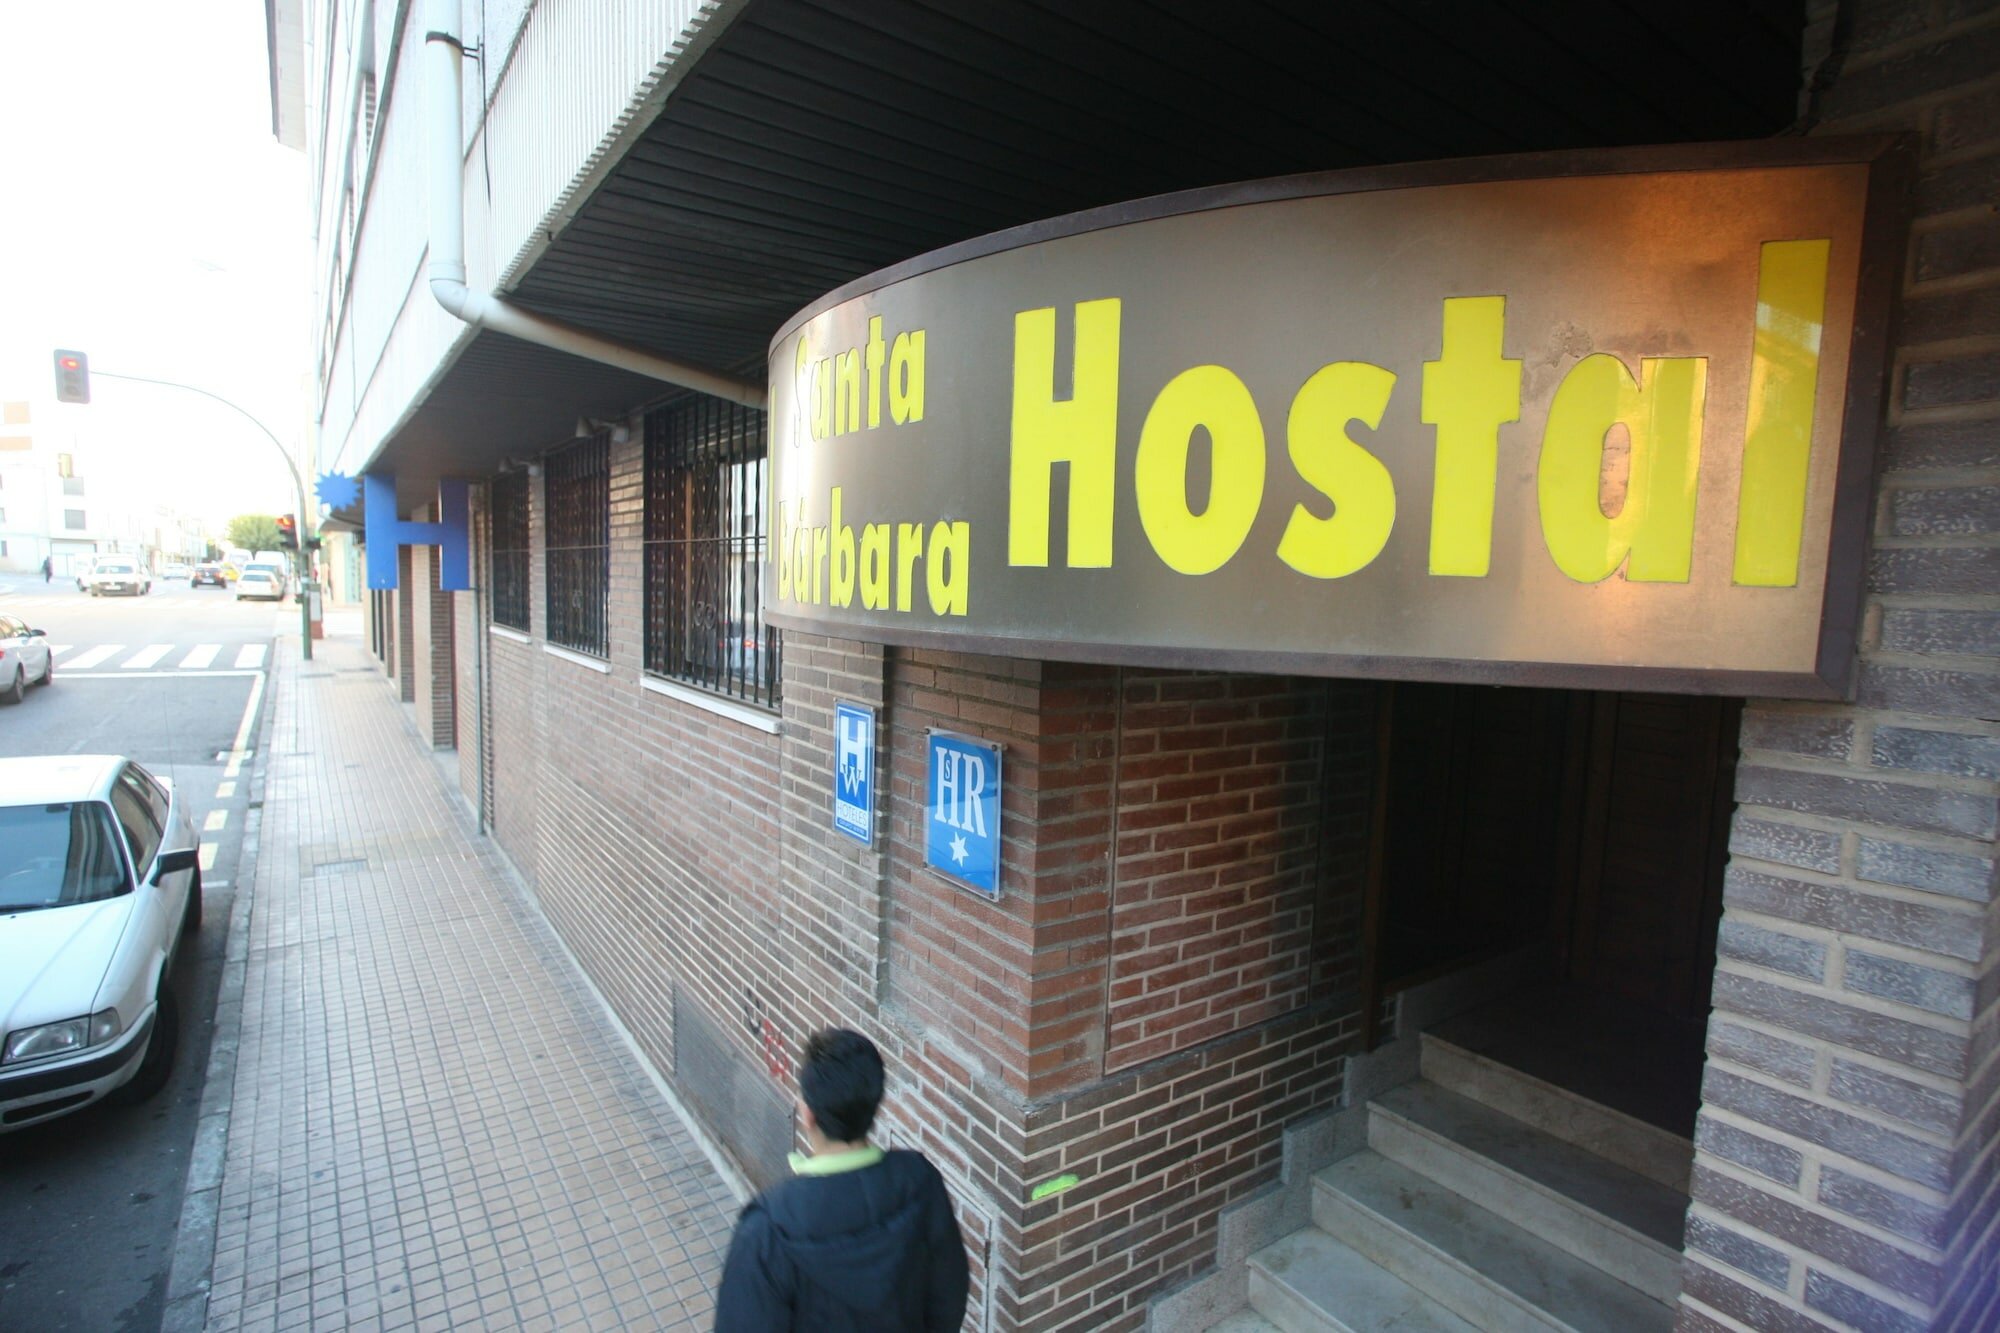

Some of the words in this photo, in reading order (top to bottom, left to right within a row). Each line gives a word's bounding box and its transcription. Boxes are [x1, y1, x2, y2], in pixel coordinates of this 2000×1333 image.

[793, 315, 926, 449] Santa
[1007, 238, 1832, 587] Hostal
[778, 486, 970, 616] Bárbara
